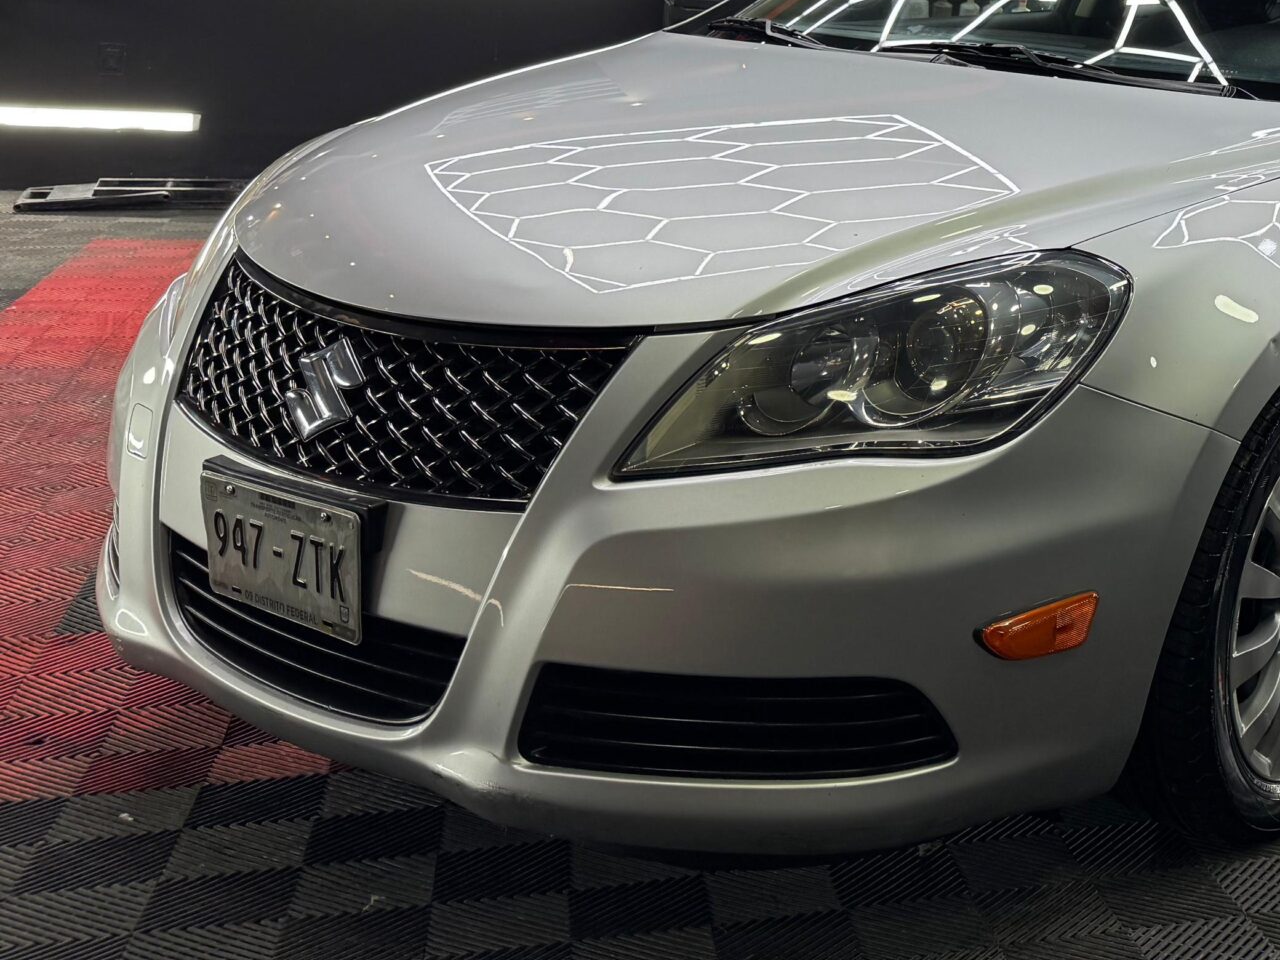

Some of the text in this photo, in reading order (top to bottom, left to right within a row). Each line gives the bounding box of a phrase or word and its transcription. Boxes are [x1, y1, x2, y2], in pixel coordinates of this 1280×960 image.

[214, 509, 345, 602] 947-ZTK
[254, 592, 285, 614] DISTRITO
[286, 604, 319, 625] FEDERAL
